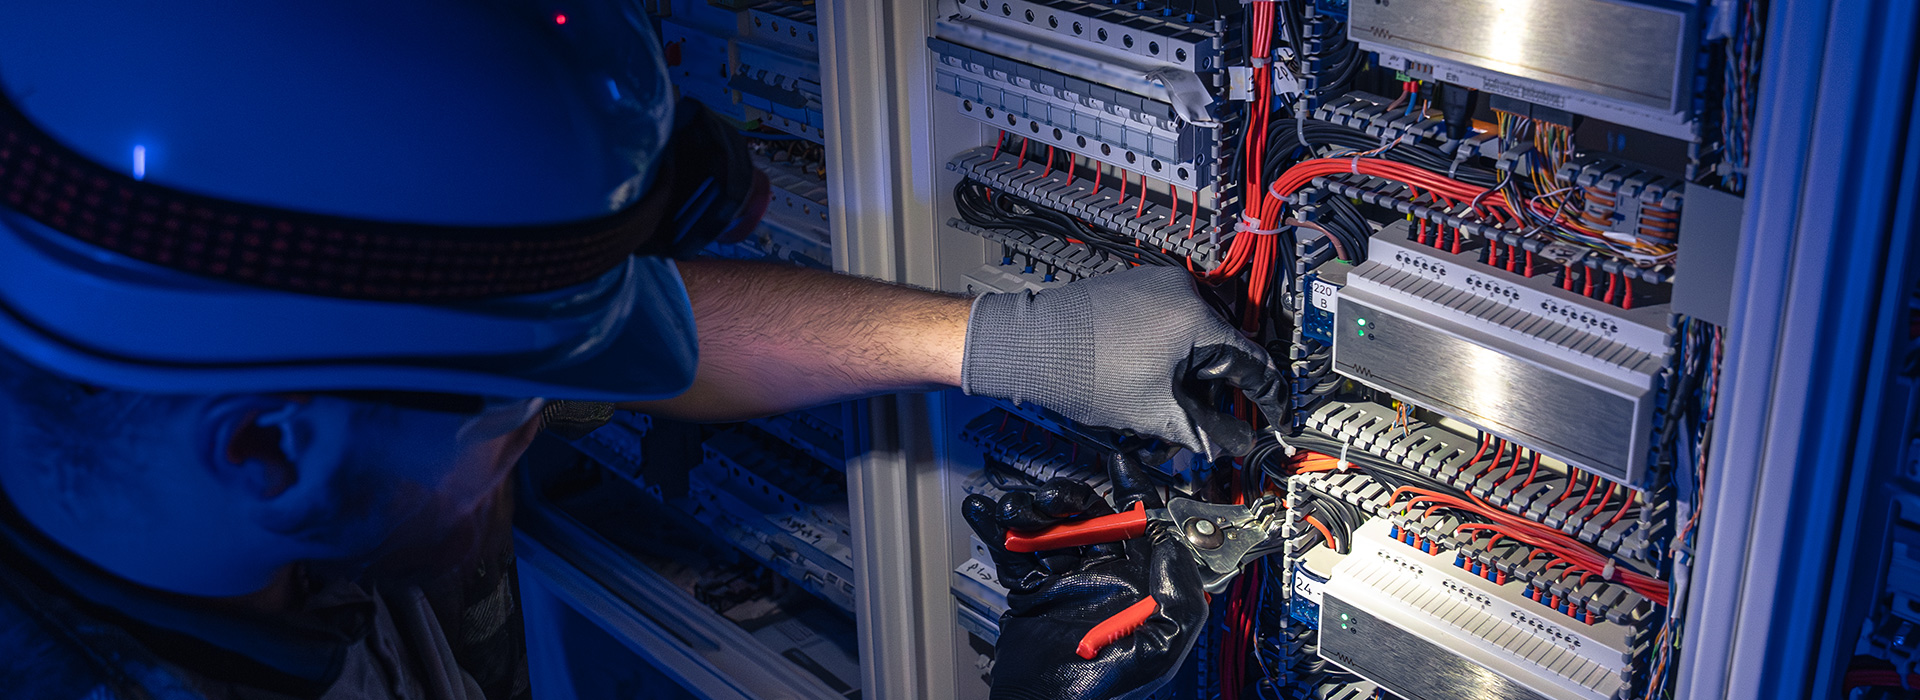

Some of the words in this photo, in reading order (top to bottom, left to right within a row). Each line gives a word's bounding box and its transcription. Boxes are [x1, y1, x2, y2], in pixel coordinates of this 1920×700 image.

[1314, 283, 1332, 296] 220
[1321, 298, 1327, 308] B
[1296, 577, 1312, 595] 24
